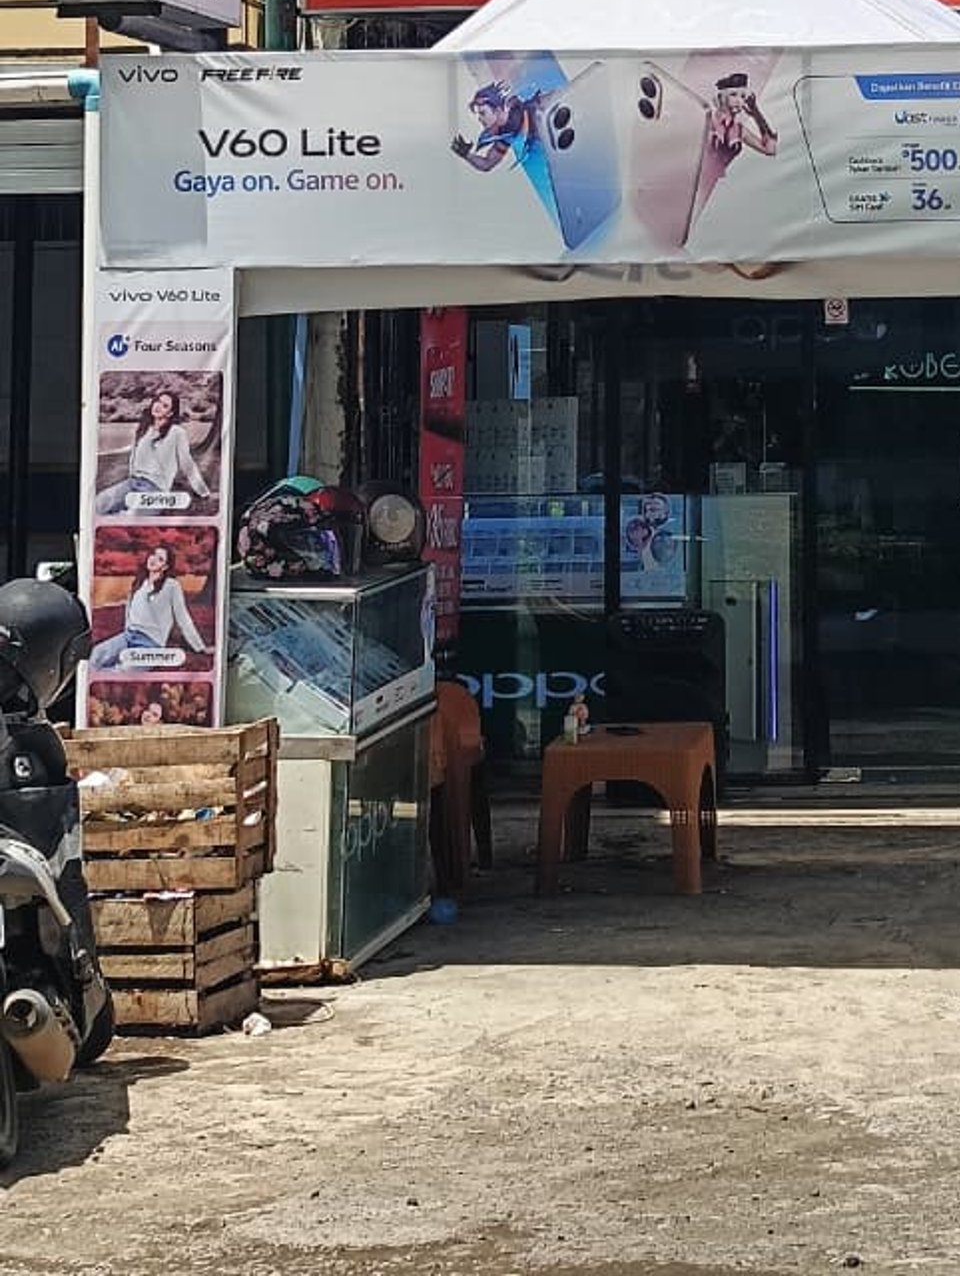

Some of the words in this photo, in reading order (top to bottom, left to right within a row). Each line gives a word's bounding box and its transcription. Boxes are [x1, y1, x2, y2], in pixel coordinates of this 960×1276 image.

[119, 65, 178, 83] vivo
[198, 129, 288, 158] V60
[301, 128, 381, 158] Lite
[174, 171, 234, 198] Gaya
[242, 174, 280, 192] on.
[287, 169, 359, 191] Game
[366, 171, 404, 191] on.
[912, 189, 943, 210] 36
[109, 288, 153, 303] vivo
[156, 290, 188, 302] V60
[192, 290, 221, 302] Lite
[135, 340, 162, 352] Four
[166, 340, 217, 352] Seasons
[140, 494, 176, 507] Spring
[129, 652, 176, 661] Summer
